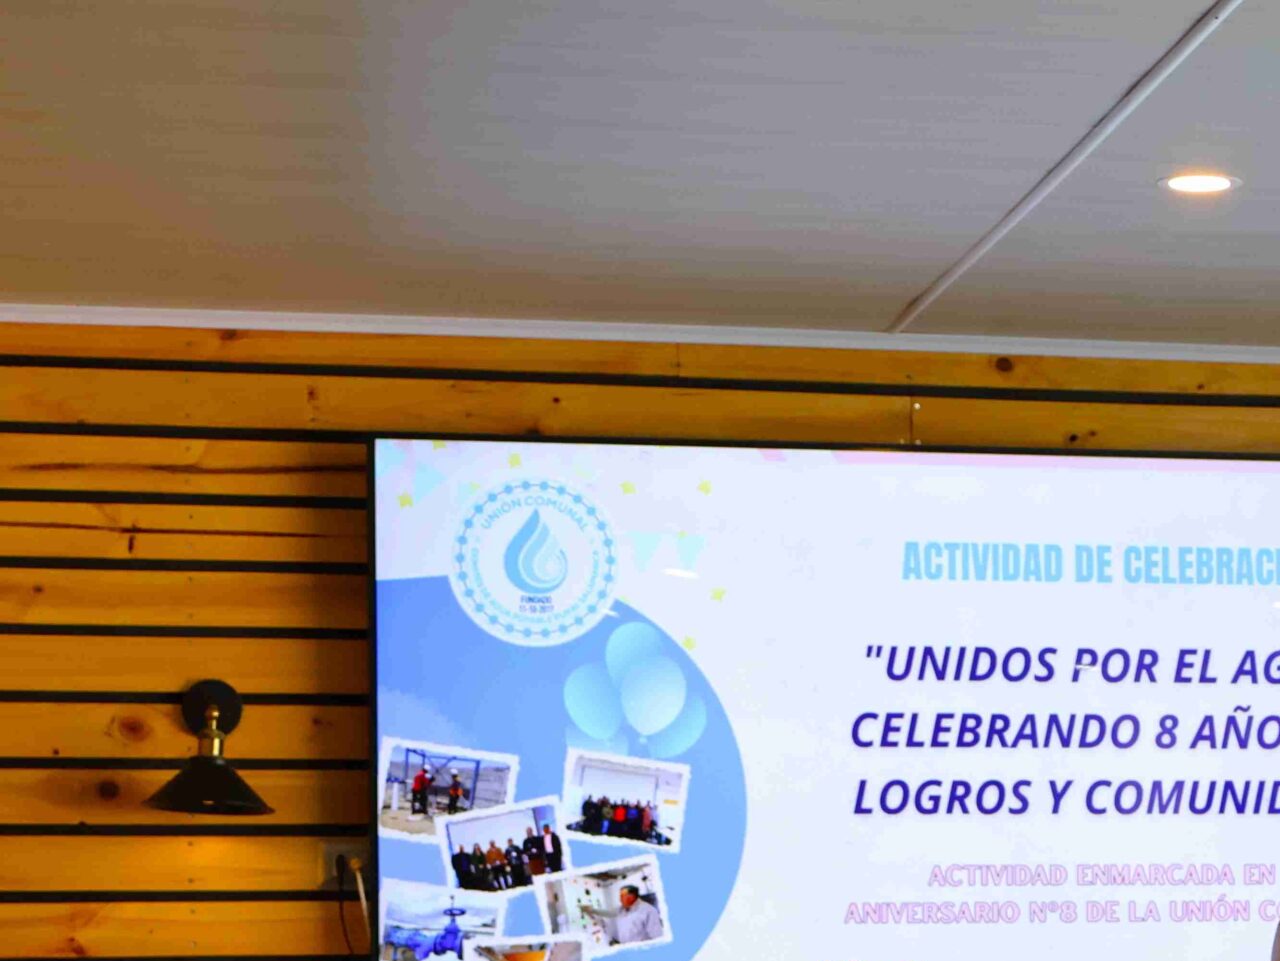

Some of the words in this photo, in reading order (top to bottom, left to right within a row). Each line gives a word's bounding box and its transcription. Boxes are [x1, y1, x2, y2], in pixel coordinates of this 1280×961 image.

[523, 495, 589, 533] COMUNAL
[902, 541, 1063, 582] ACTIVIDAD
[1074, 544, 1113, 583] DE
[866, 645, 1058, 682] "UNIDOS
[1071, 647, 1159, 684] POR
[1173, 648, 1218, 684] EL
[851, 712, 1141, 749] CELEBRANDO
[1154, 714, 1179, 750] 8
[853, 779, 1033, 815] LOGROS
[1048, 779, 1075, 815] Y
[928, 864, 1068, 887] ACTIVIDAD
[1076, 863, 1236, 886] ENMARCADA
[1243, 863, 1276, 885] EN
[844, 901, 1021, 924] ANIVERSARIO
[1086, 900, 1120, 923] DE
[1128, 900, 1161, 923] LA
[1169, 893, 1251, 923] UNIÓN
